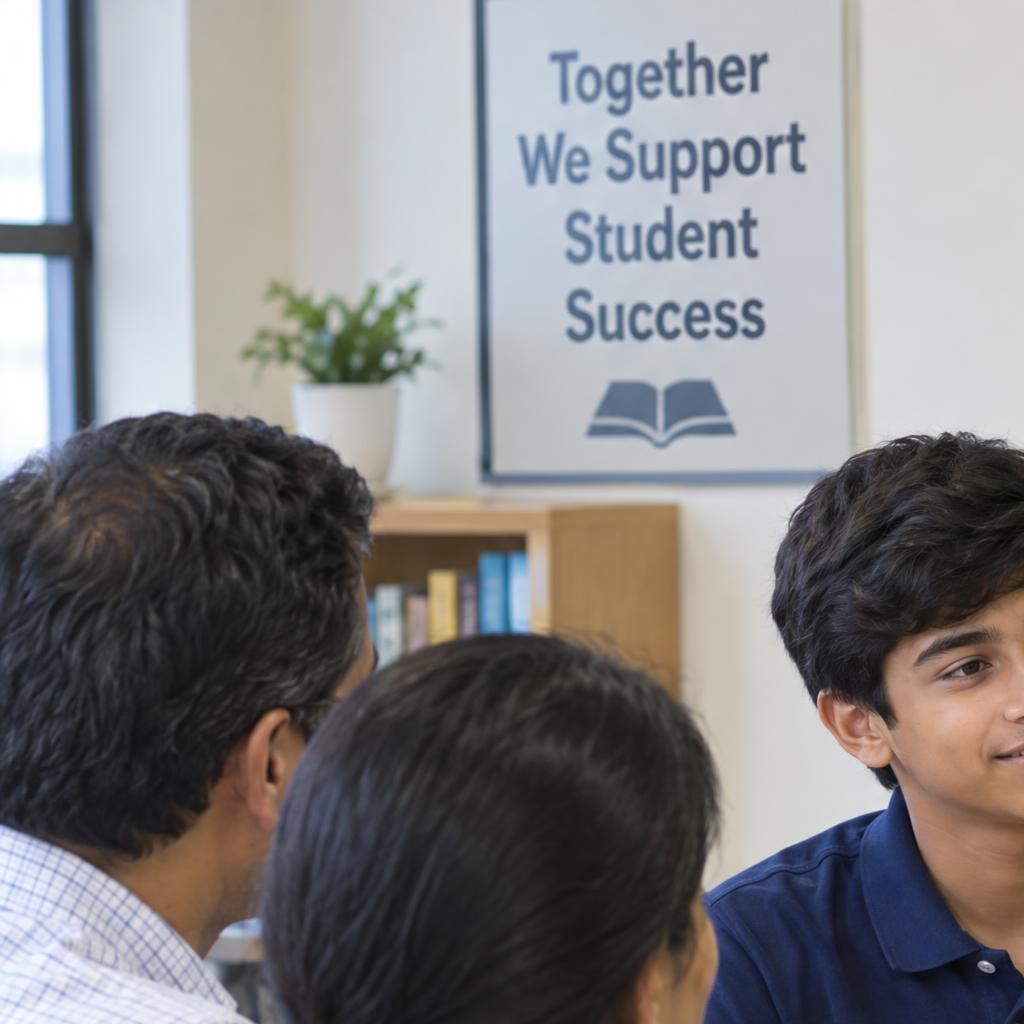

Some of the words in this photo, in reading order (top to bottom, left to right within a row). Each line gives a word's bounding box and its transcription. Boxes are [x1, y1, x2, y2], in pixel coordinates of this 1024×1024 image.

[548, 40, 769, 117] Together
[517, 131, 591, 187] We
[605, 122, 807, 195] Support
[564, 205, 759, 265] Student
[565, 288, 766, 343] Success
